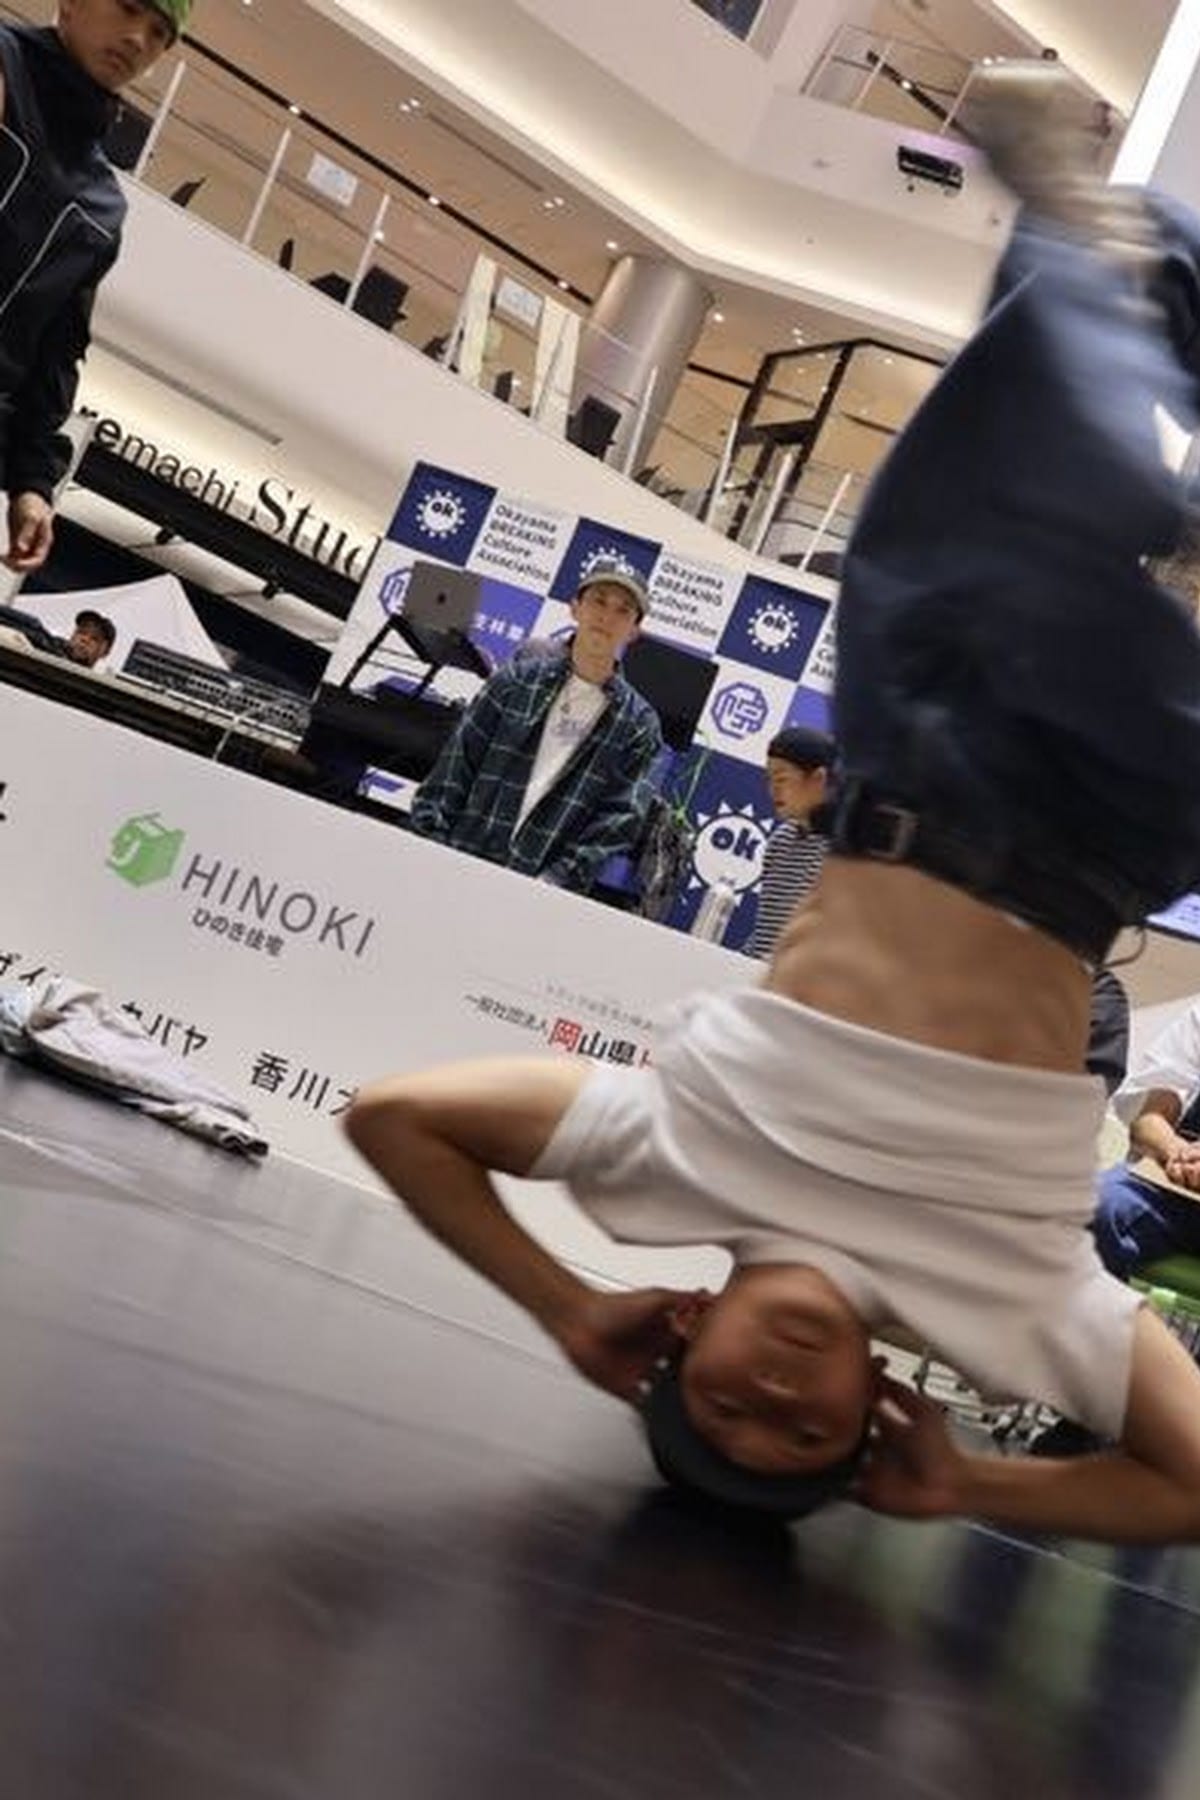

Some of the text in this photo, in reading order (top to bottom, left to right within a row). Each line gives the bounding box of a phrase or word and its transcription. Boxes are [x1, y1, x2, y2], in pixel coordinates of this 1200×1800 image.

[430, 501, 455, 519] ok
[495, 504, 557, 534] Okayama
[482, 533, 532, 558] Culture
[488, 519, 557, 551] BREAKING
[475, 549, 551, 583] Association
[661, 560, 725, 591] Okayama
[654, 576, 724, 608] BREAKING
[648, 609, 719, 638] ssociation
[761, 614, 788, 633] ok
[710, 826, 761, 862] ok
[181, 853, 375, 957] HINOKI
